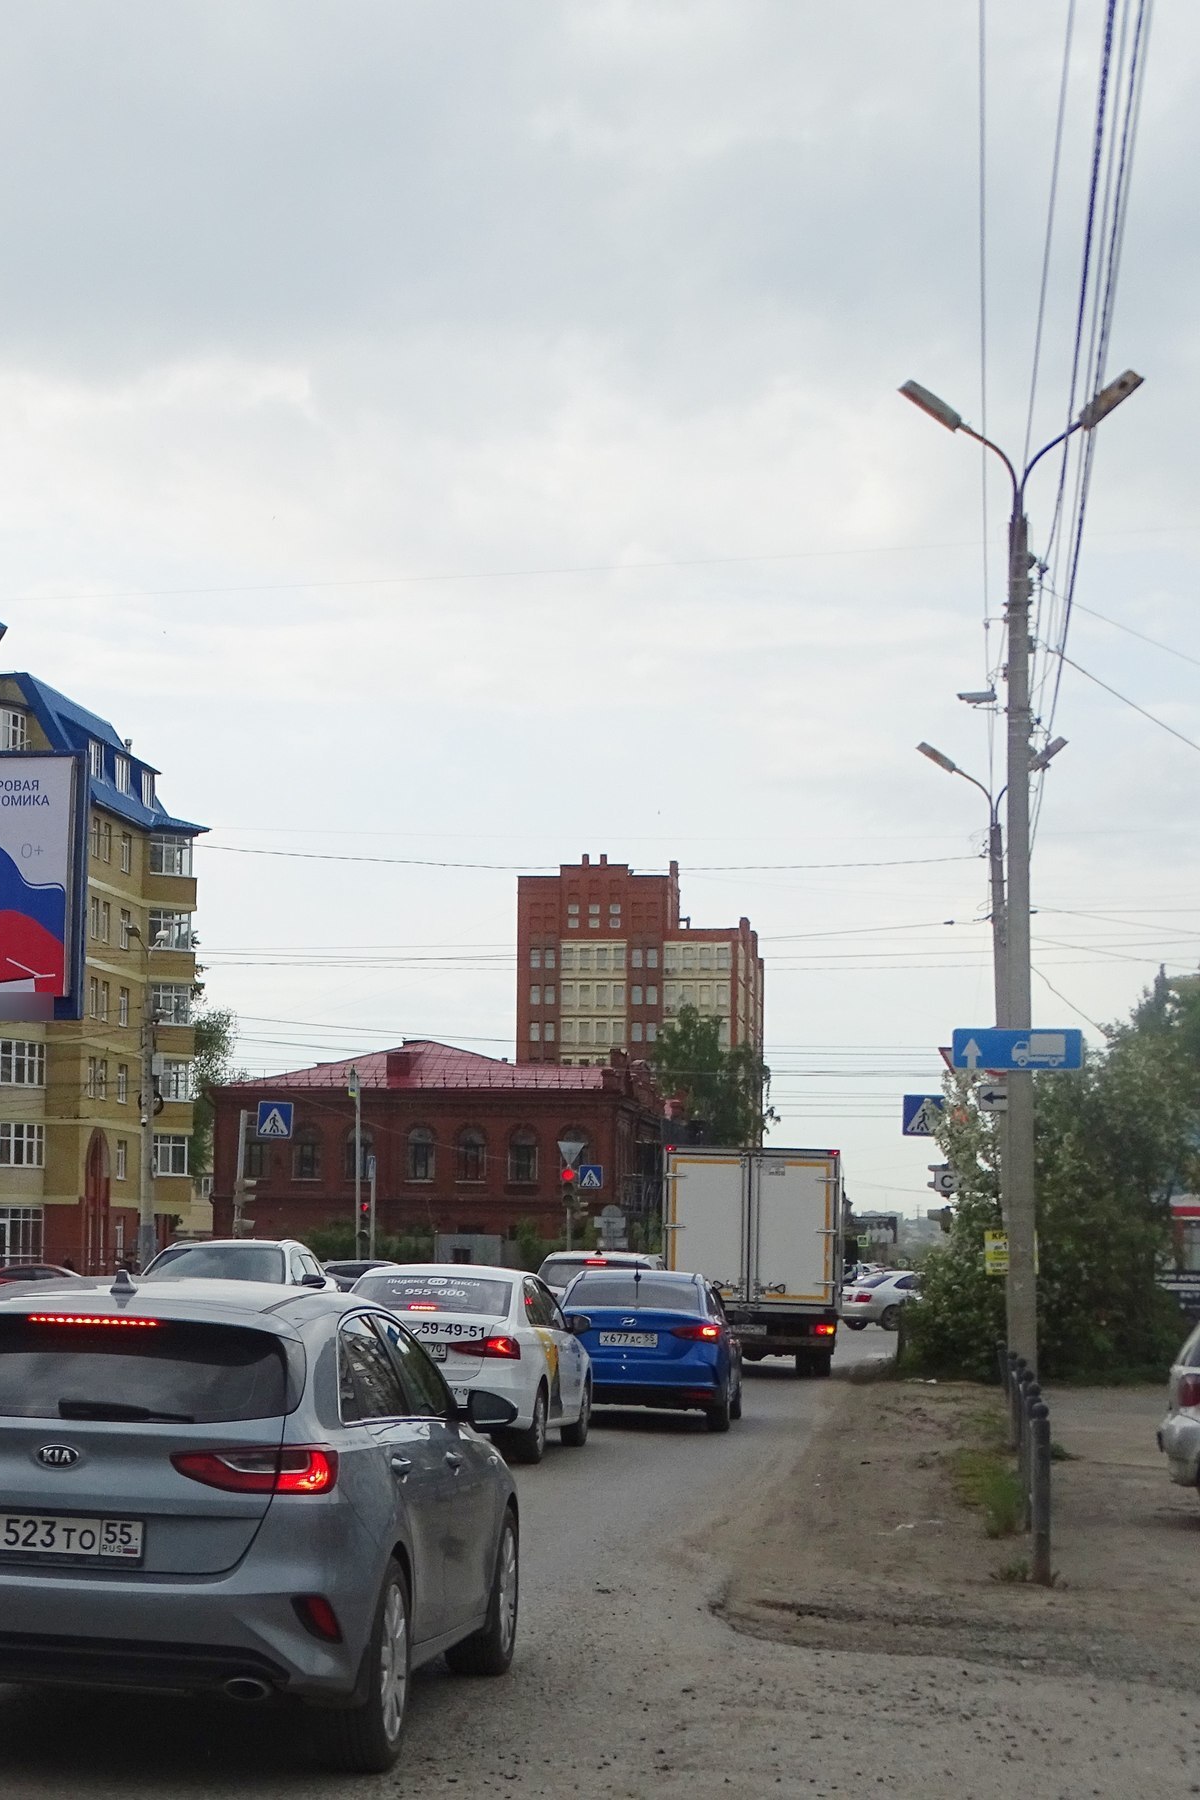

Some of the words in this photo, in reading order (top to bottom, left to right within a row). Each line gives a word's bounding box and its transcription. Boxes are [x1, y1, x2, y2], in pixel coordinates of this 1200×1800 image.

[21, 843, 44, 859] 0+
[404, 1288, 466, 1297] 955-000
[421, 1322, 485, 1338] 59-49-51
[43, 1449, 72, 1463] KIA
[104, 1522, 132, 1545] 55
[102, 1544, 121, 1554] RUS
